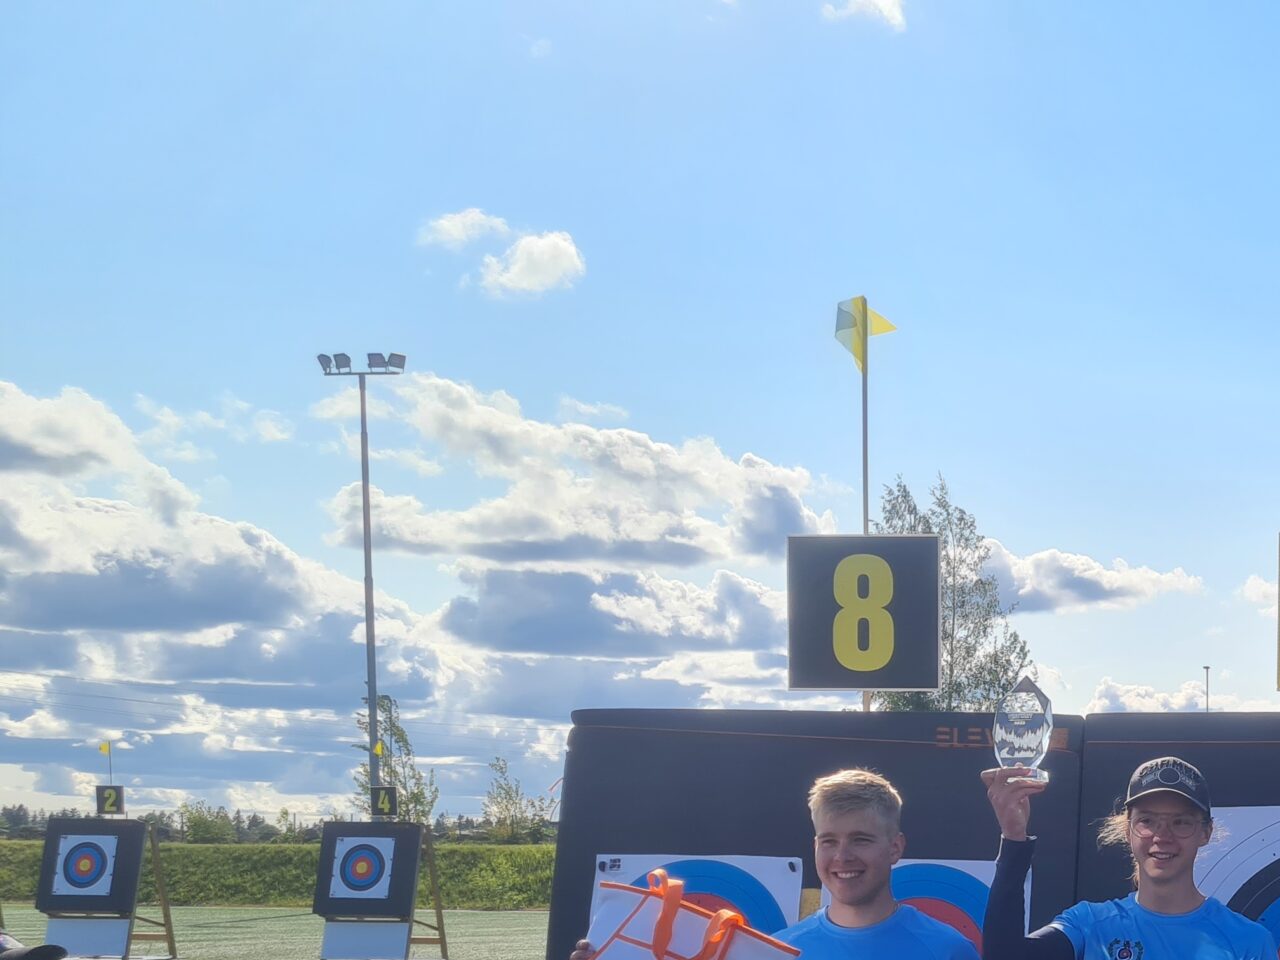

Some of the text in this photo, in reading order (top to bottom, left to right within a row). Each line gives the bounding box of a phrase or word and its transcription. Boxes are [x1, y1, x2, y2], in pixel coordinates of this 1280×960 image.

[832, 552, 895, 672] 8
[104, 788, 117, 811] 2
[378, 790, 390, 813] 4
